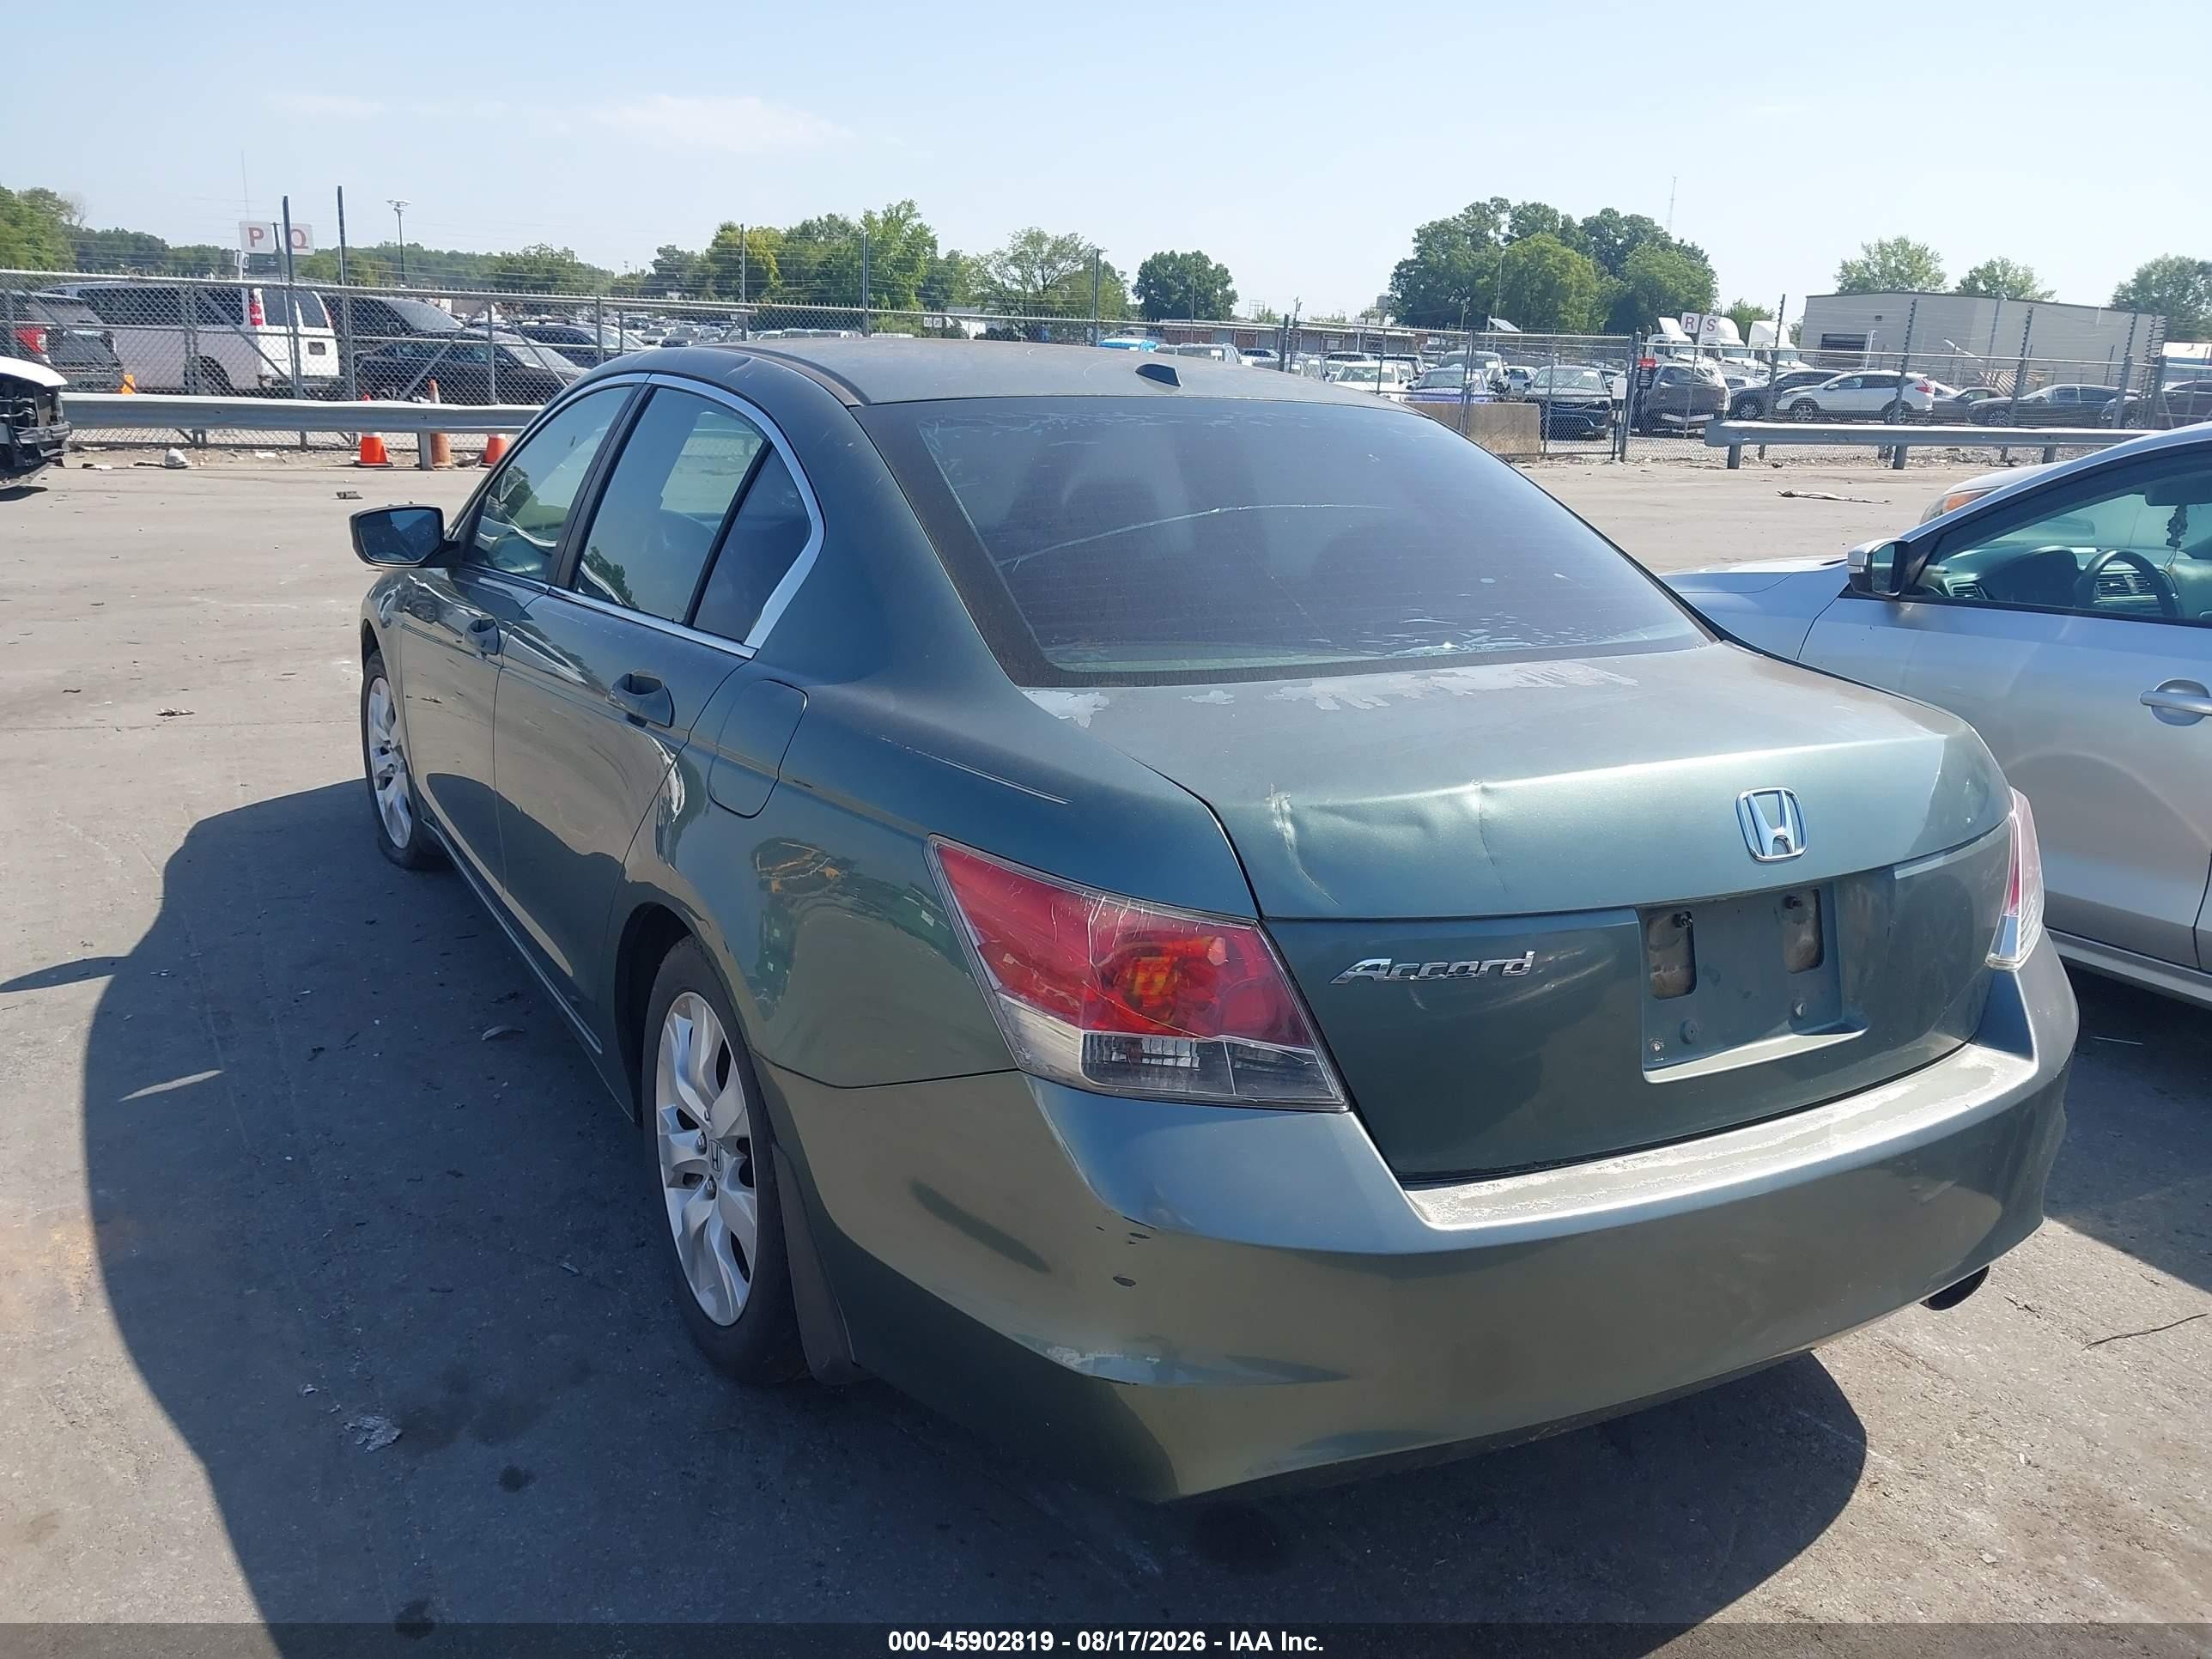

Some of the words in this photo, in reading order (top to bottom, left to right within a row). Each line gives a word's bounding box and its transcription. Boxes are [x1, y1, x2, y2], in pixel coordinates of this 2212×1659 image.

[248, 227, 264, 247] P
[290, 228, 309, 249] Q
[1685, 316, 1694, 330] R
[1706, 319, 1717, 331] S
[1330, 951, 1535, 984] Accord
